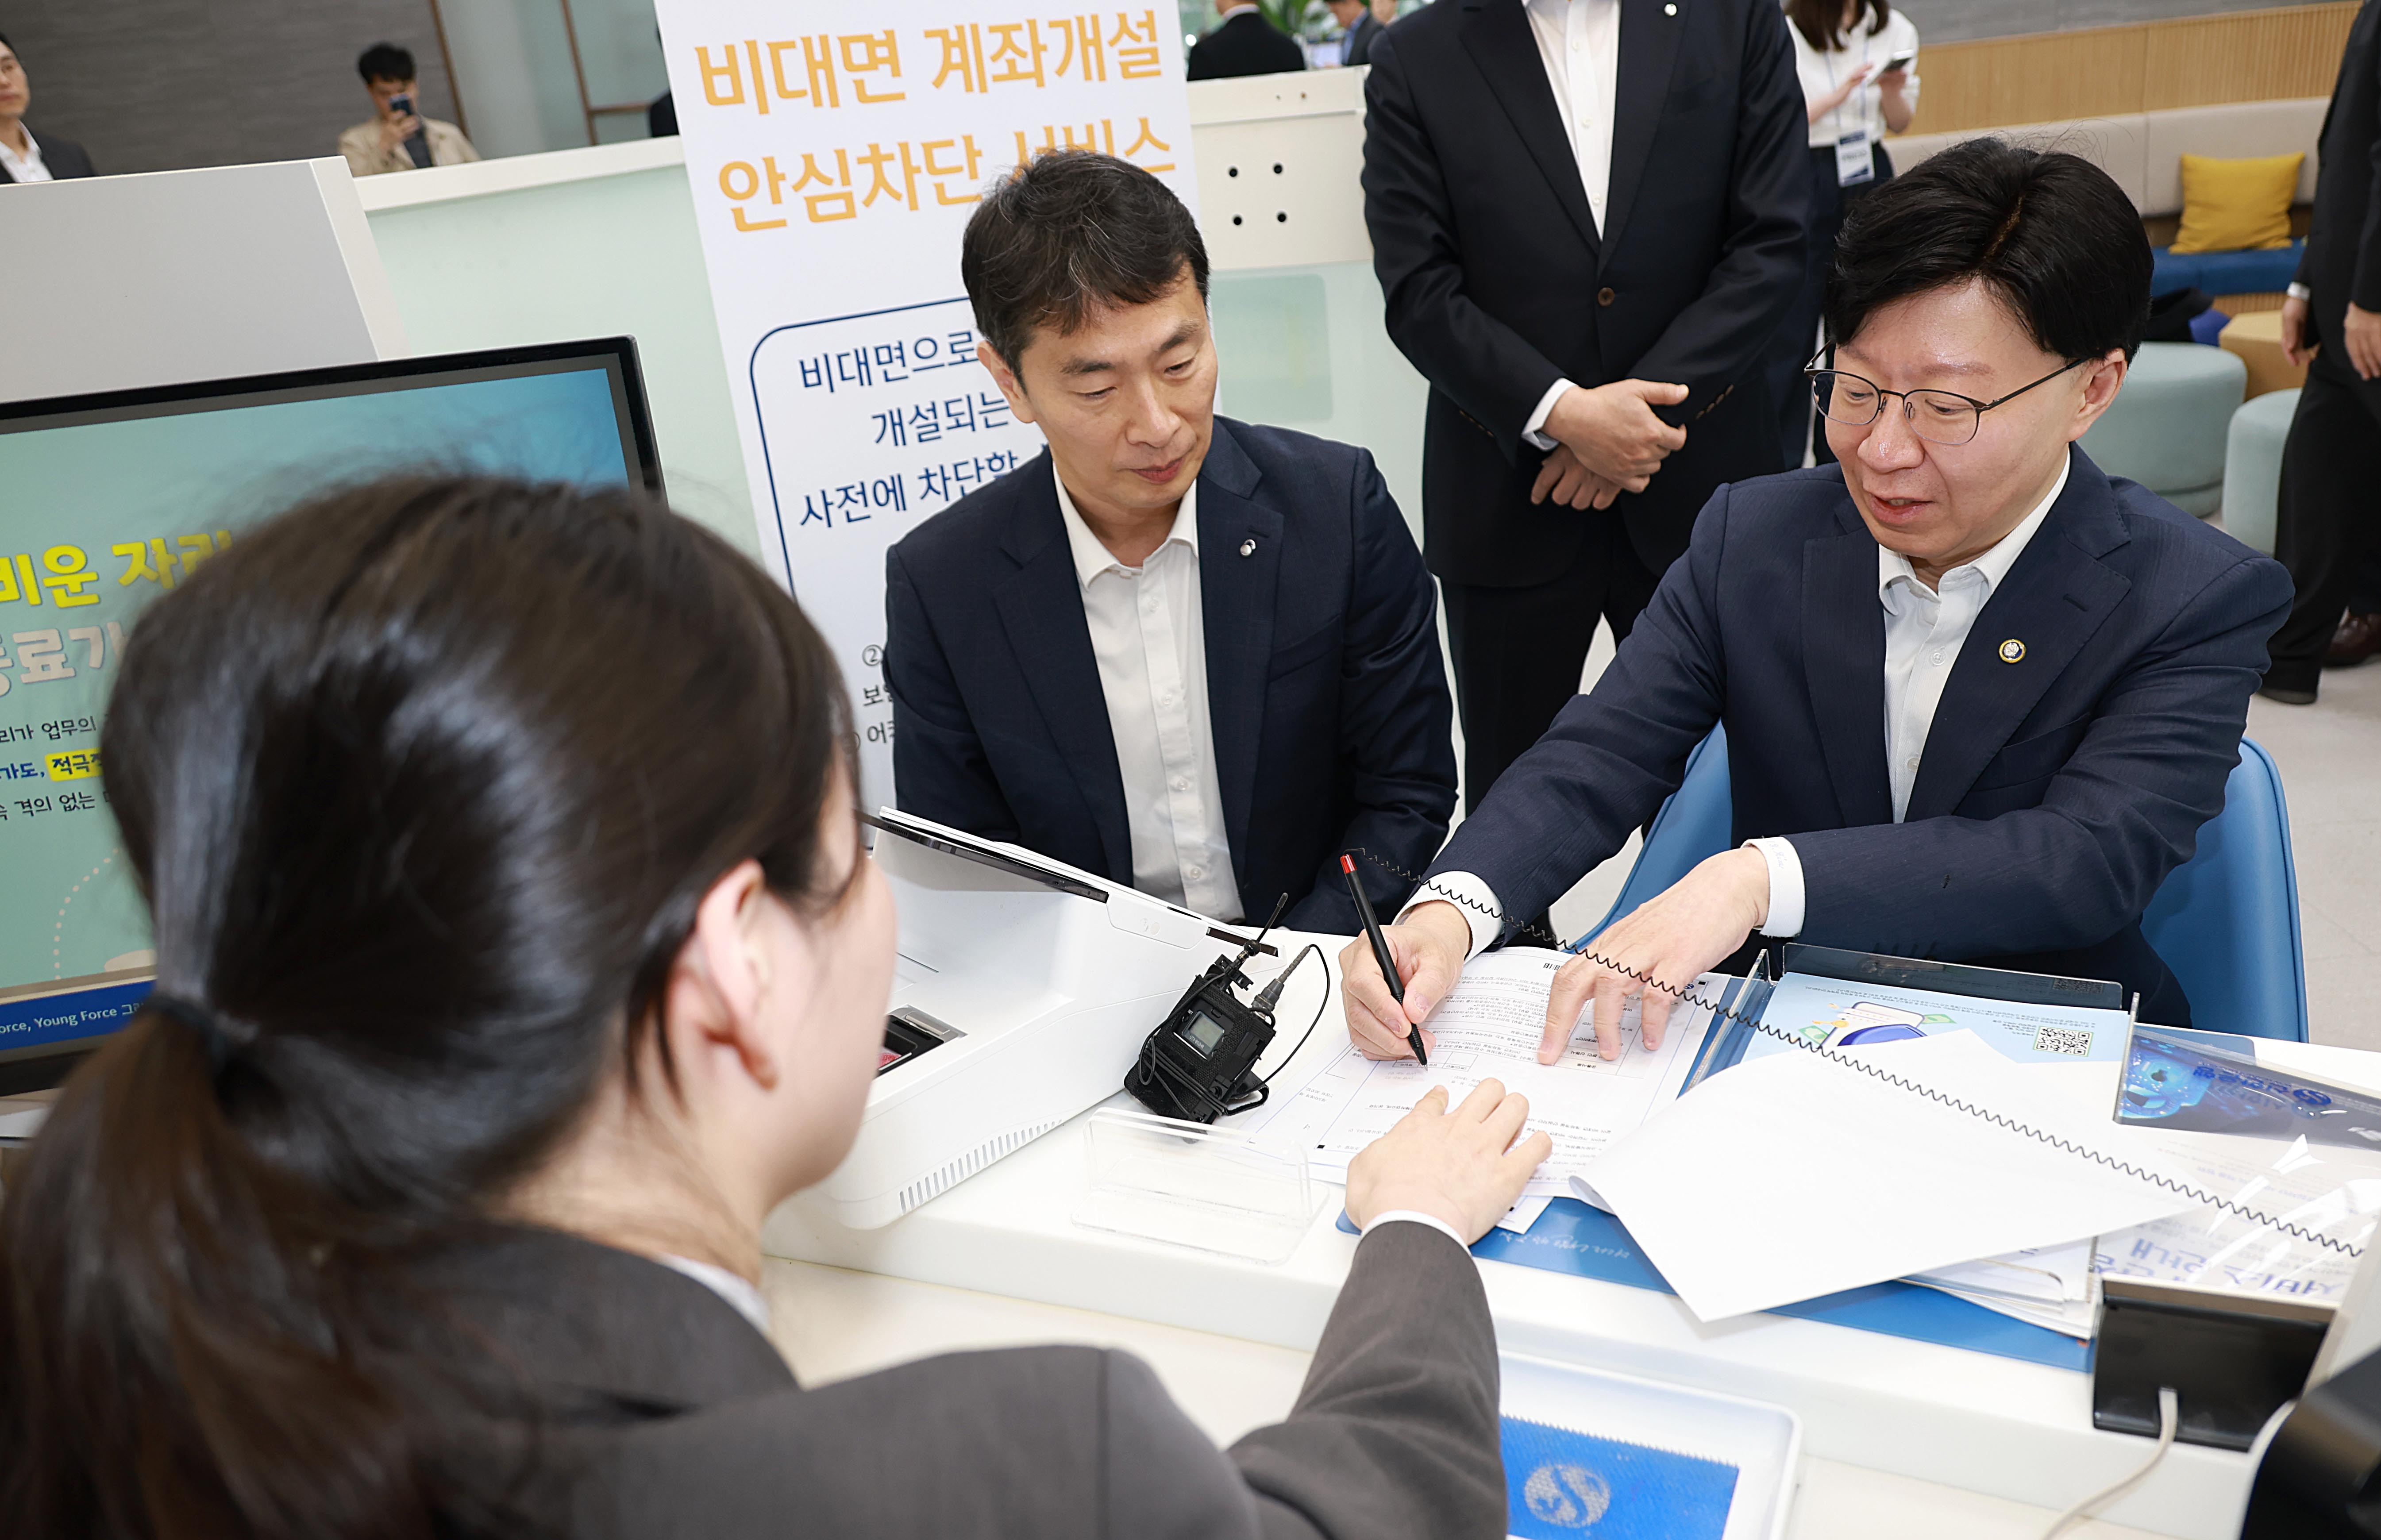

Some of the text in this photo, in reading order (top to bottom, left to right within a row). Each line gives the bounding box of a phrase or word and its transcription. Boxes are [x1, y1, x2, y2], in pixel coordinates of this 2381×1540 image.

[694, 9, 1162, 115] 비대면 계좌개설
[717, 134, 982, 233] 안심차단
[798, 330, 979, 394] 비대면으로
[871, 393, 1010, 448] 개설되는
[799, 473, 908, 529] 사전에
[42, 716, 96, 740] 업무의
[14, 796, 52, 816] 격의
[59, 791, 95, 812] 없는
[34, 1014, 78, 1028] Young
[80, 1007, 117, 1021] Force
[2129, 1239, 2206, 1273] 안내
[2223, 1266, 2344, 1294] 서비스
